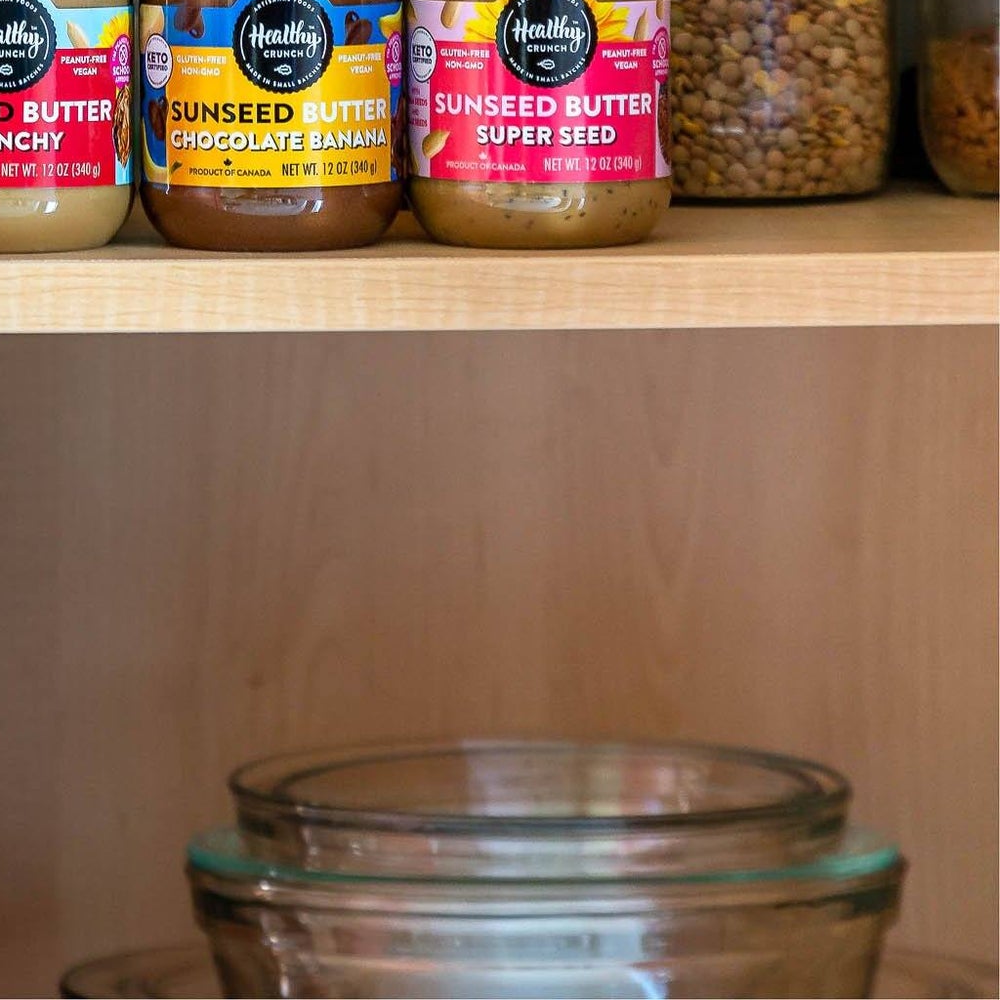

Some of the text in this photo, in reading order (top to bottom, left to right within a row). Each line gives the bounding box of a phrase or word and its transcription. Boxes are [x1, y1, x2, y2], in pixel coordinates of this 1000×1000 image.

[249, 21, 322, 58] Healthy
[513, 15, 586, 53] Healthy
[264, 50, 303, 58] CRUNCH
[412, 45, 432, 58] KETO
[440, 49, 490, 59] GLUTEN-FREE
[527, 44, 567, 52] CRUNCH
[602, 49, 647, 58] PEANUT-FREE
[61, 55, 107, 64] PEANUT-FREE
[148, 51, 168, 63] KETO
[73, 67, 97, 75] VEGAN
[112, 66, 130, 76] SCHOO
[350, 65, 373, 73] VEGAN
[445, 61, 483, 70] NON-GMO
[508, 57, 524, 75] MADE
[561, 57, 586, 80] BATCHES
[614, 61, 638, 70] VEGAN
[18, 63, 44, 86] BATCHES
[246, 63, 262, 80] MADE
[297, 63, 322, 86] BATCHES
[23, 100, 111, 123] BUTTER
[171, 98, 386, 123] SUNSEED BUTTER
[435, 93, 651, 117] SUNSEED BUTTER
[170, 128, 387, 151] CHOCOLATE BANANA
[476, 125, 616, 146] SUPER SEED
[2, 161, 100, 177] NET WT. 12 OZ (340 g)
[282, 159, 377, 176] NET WT. 12 OZ (340 g)
[446, 161, 479, 169] PRODUCT
[492, 163, 526, 172] CANADA
[544, 156, 642, 172] NET WT. 12 OZ (340 g)
[189, 167, 223, 176] PRODUCT
[237, 168, 271, 177] CANADA
